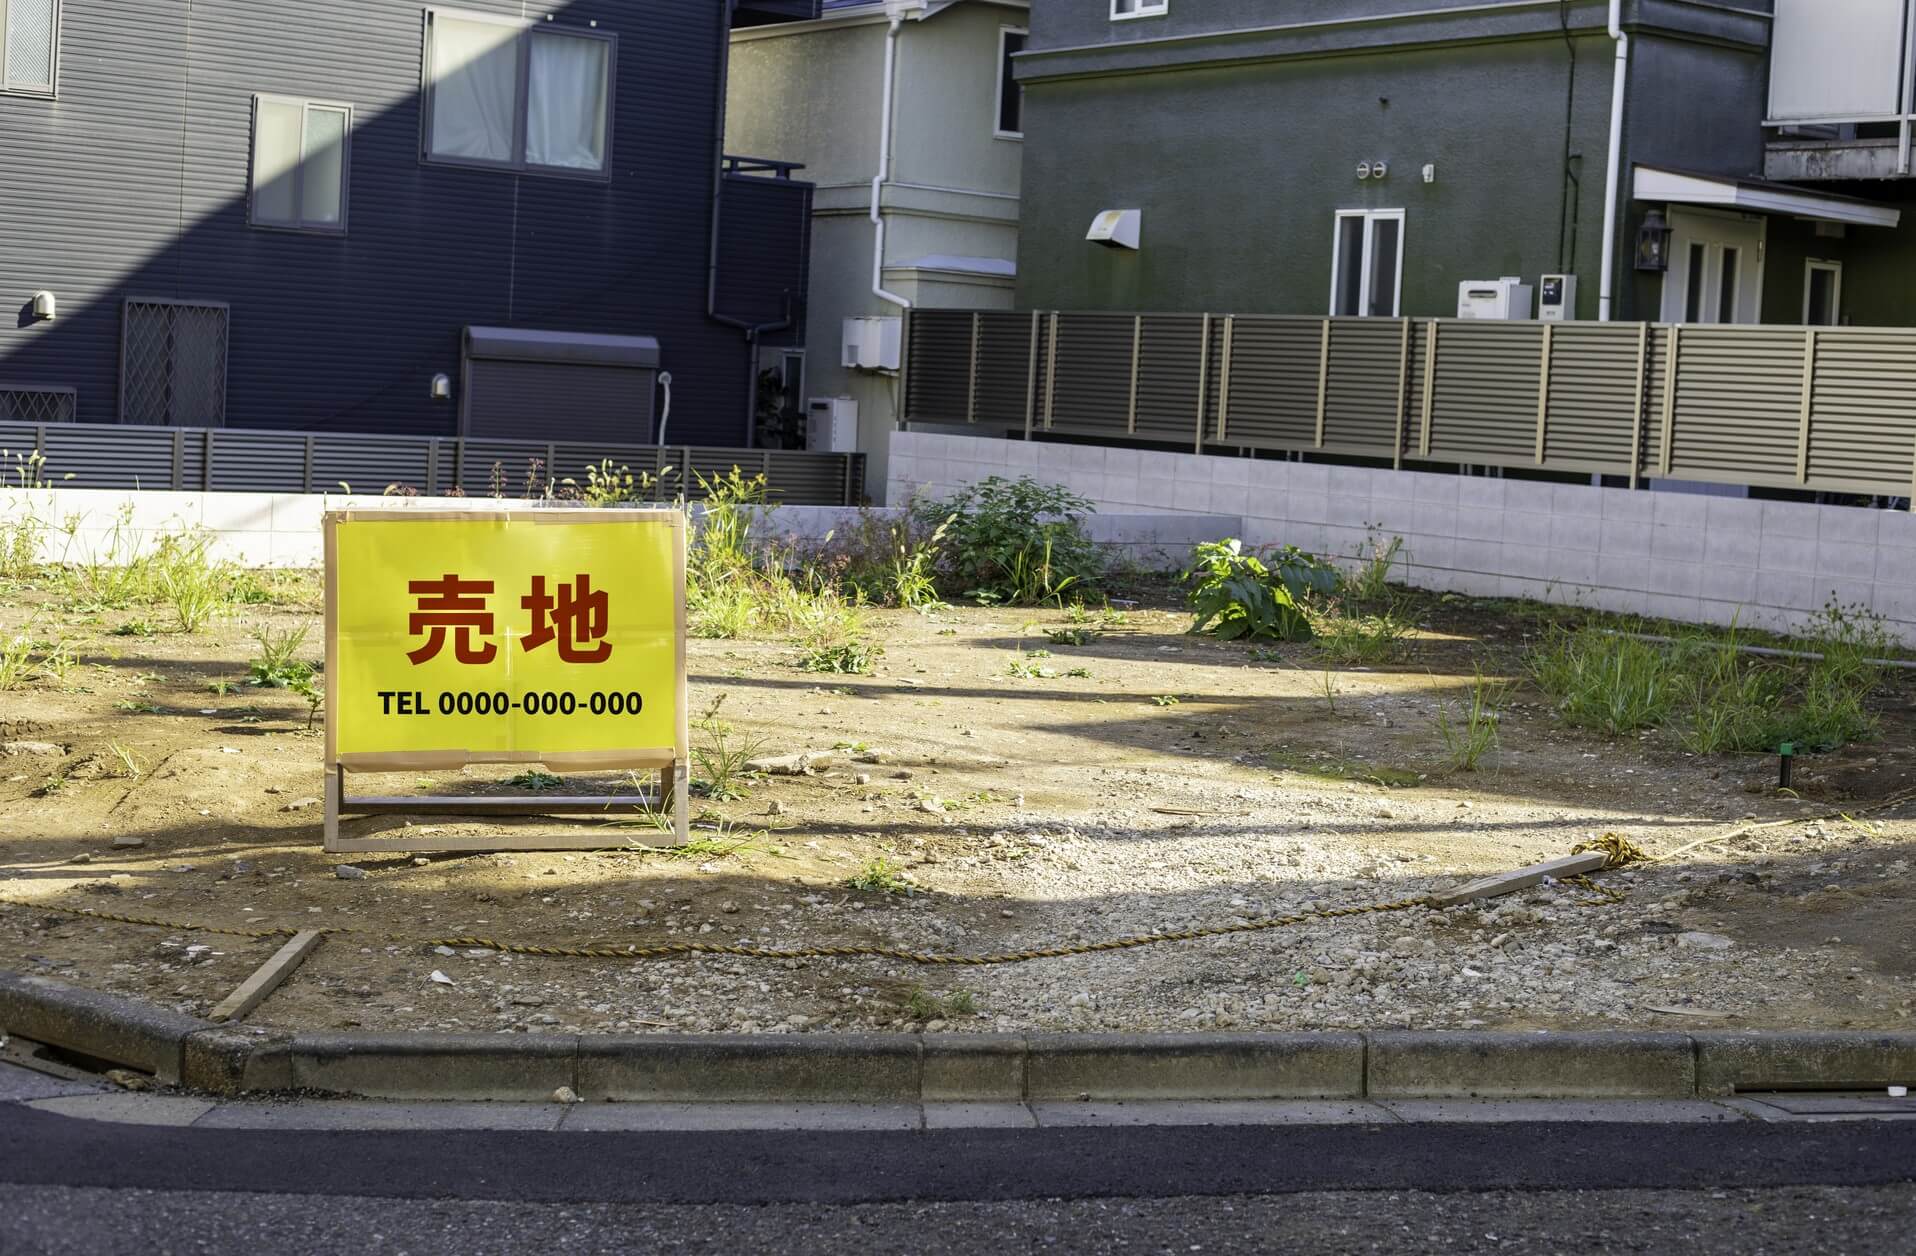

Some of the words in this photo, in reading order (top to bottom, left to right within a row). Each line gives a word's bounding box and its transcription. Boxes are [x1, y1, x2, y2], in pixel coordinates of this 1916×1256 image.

[406, 574, 613, 665] 売地
[378, 691, 430, 715] TEL
[438, 691, 643, 716] 0000-000-000
